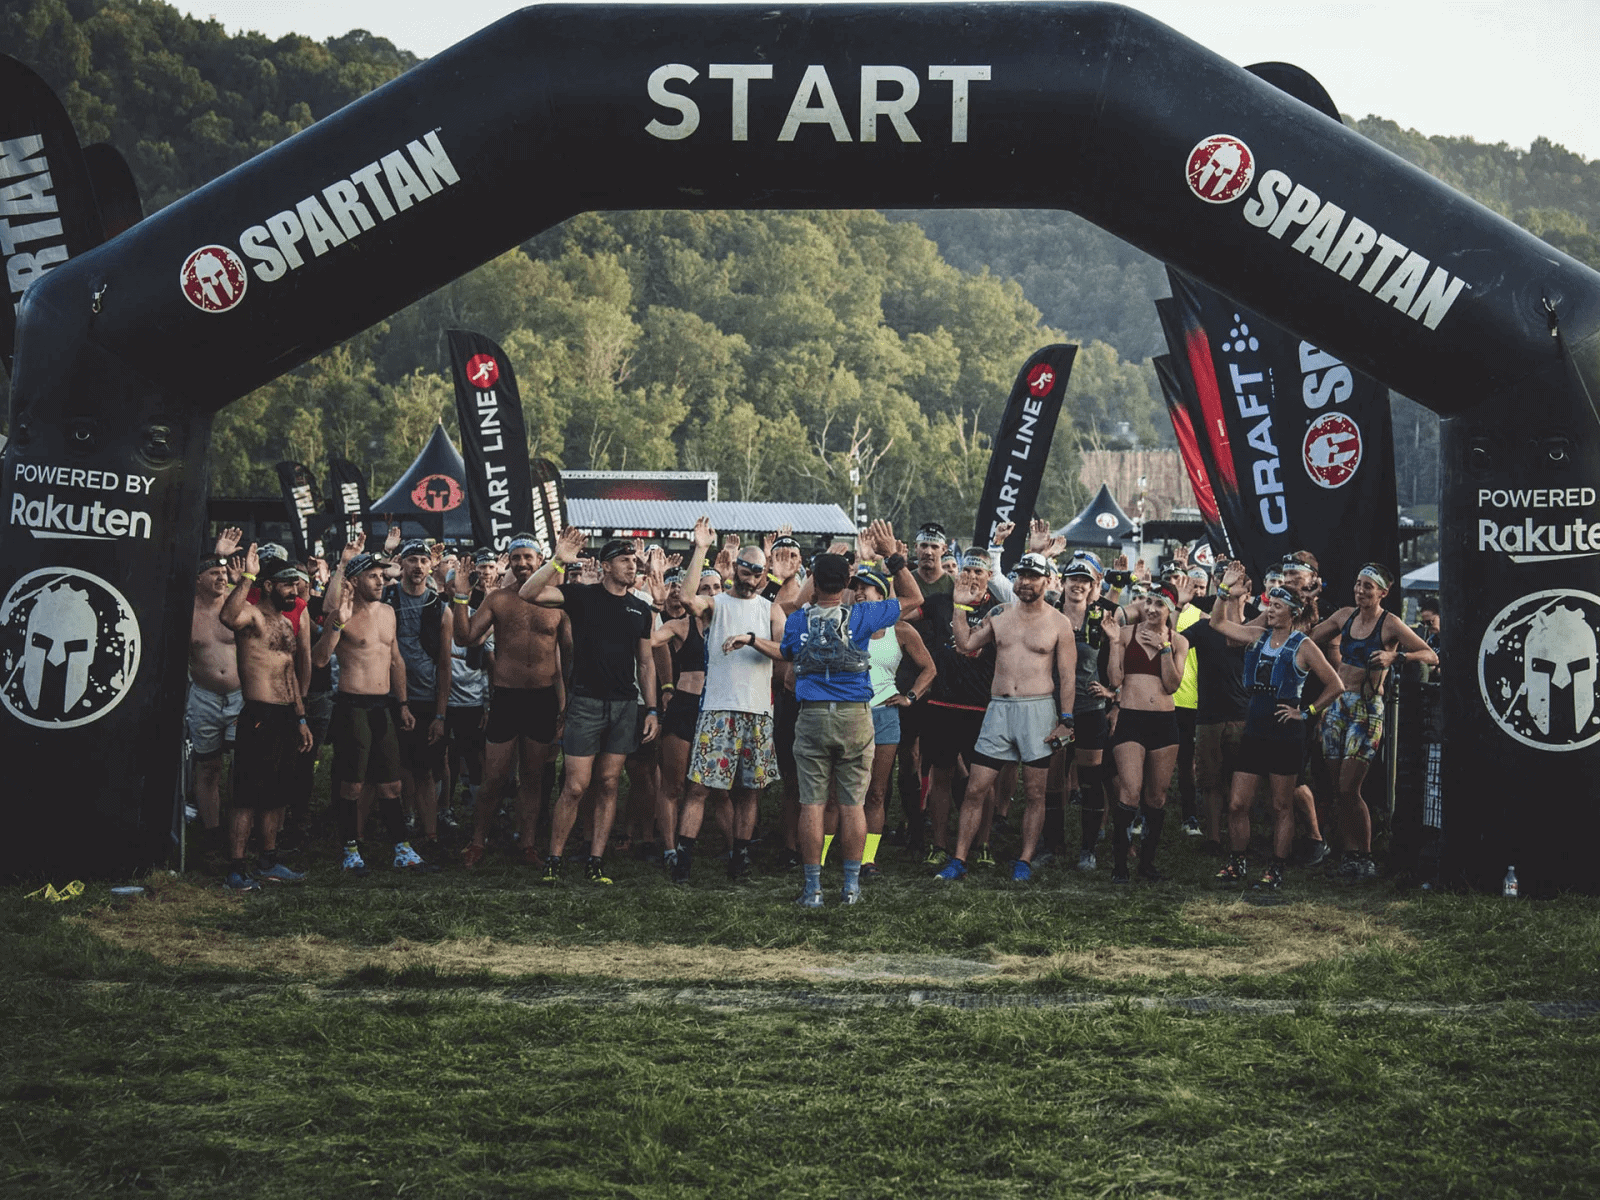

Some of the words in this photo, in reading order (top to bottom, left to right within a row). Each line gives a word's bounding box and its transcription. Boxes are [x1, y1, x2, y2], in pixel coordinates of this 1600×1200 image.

[644, 63, 991, 142] START
[0, 134, 69, 310] RTAN
[476, 390, 504, 452] LINE
[1011, 397, 1043, 460] LINE
[1229, 363, 1288, 534] CRAFT
[15, 463, 119, 491] POWERED
[125, 474, 156, 495] BY
[485, 461, 512, 552] START
[1478, 487, 1596, 508] POWERED
[10, 492, 152, 539] Rakuten
